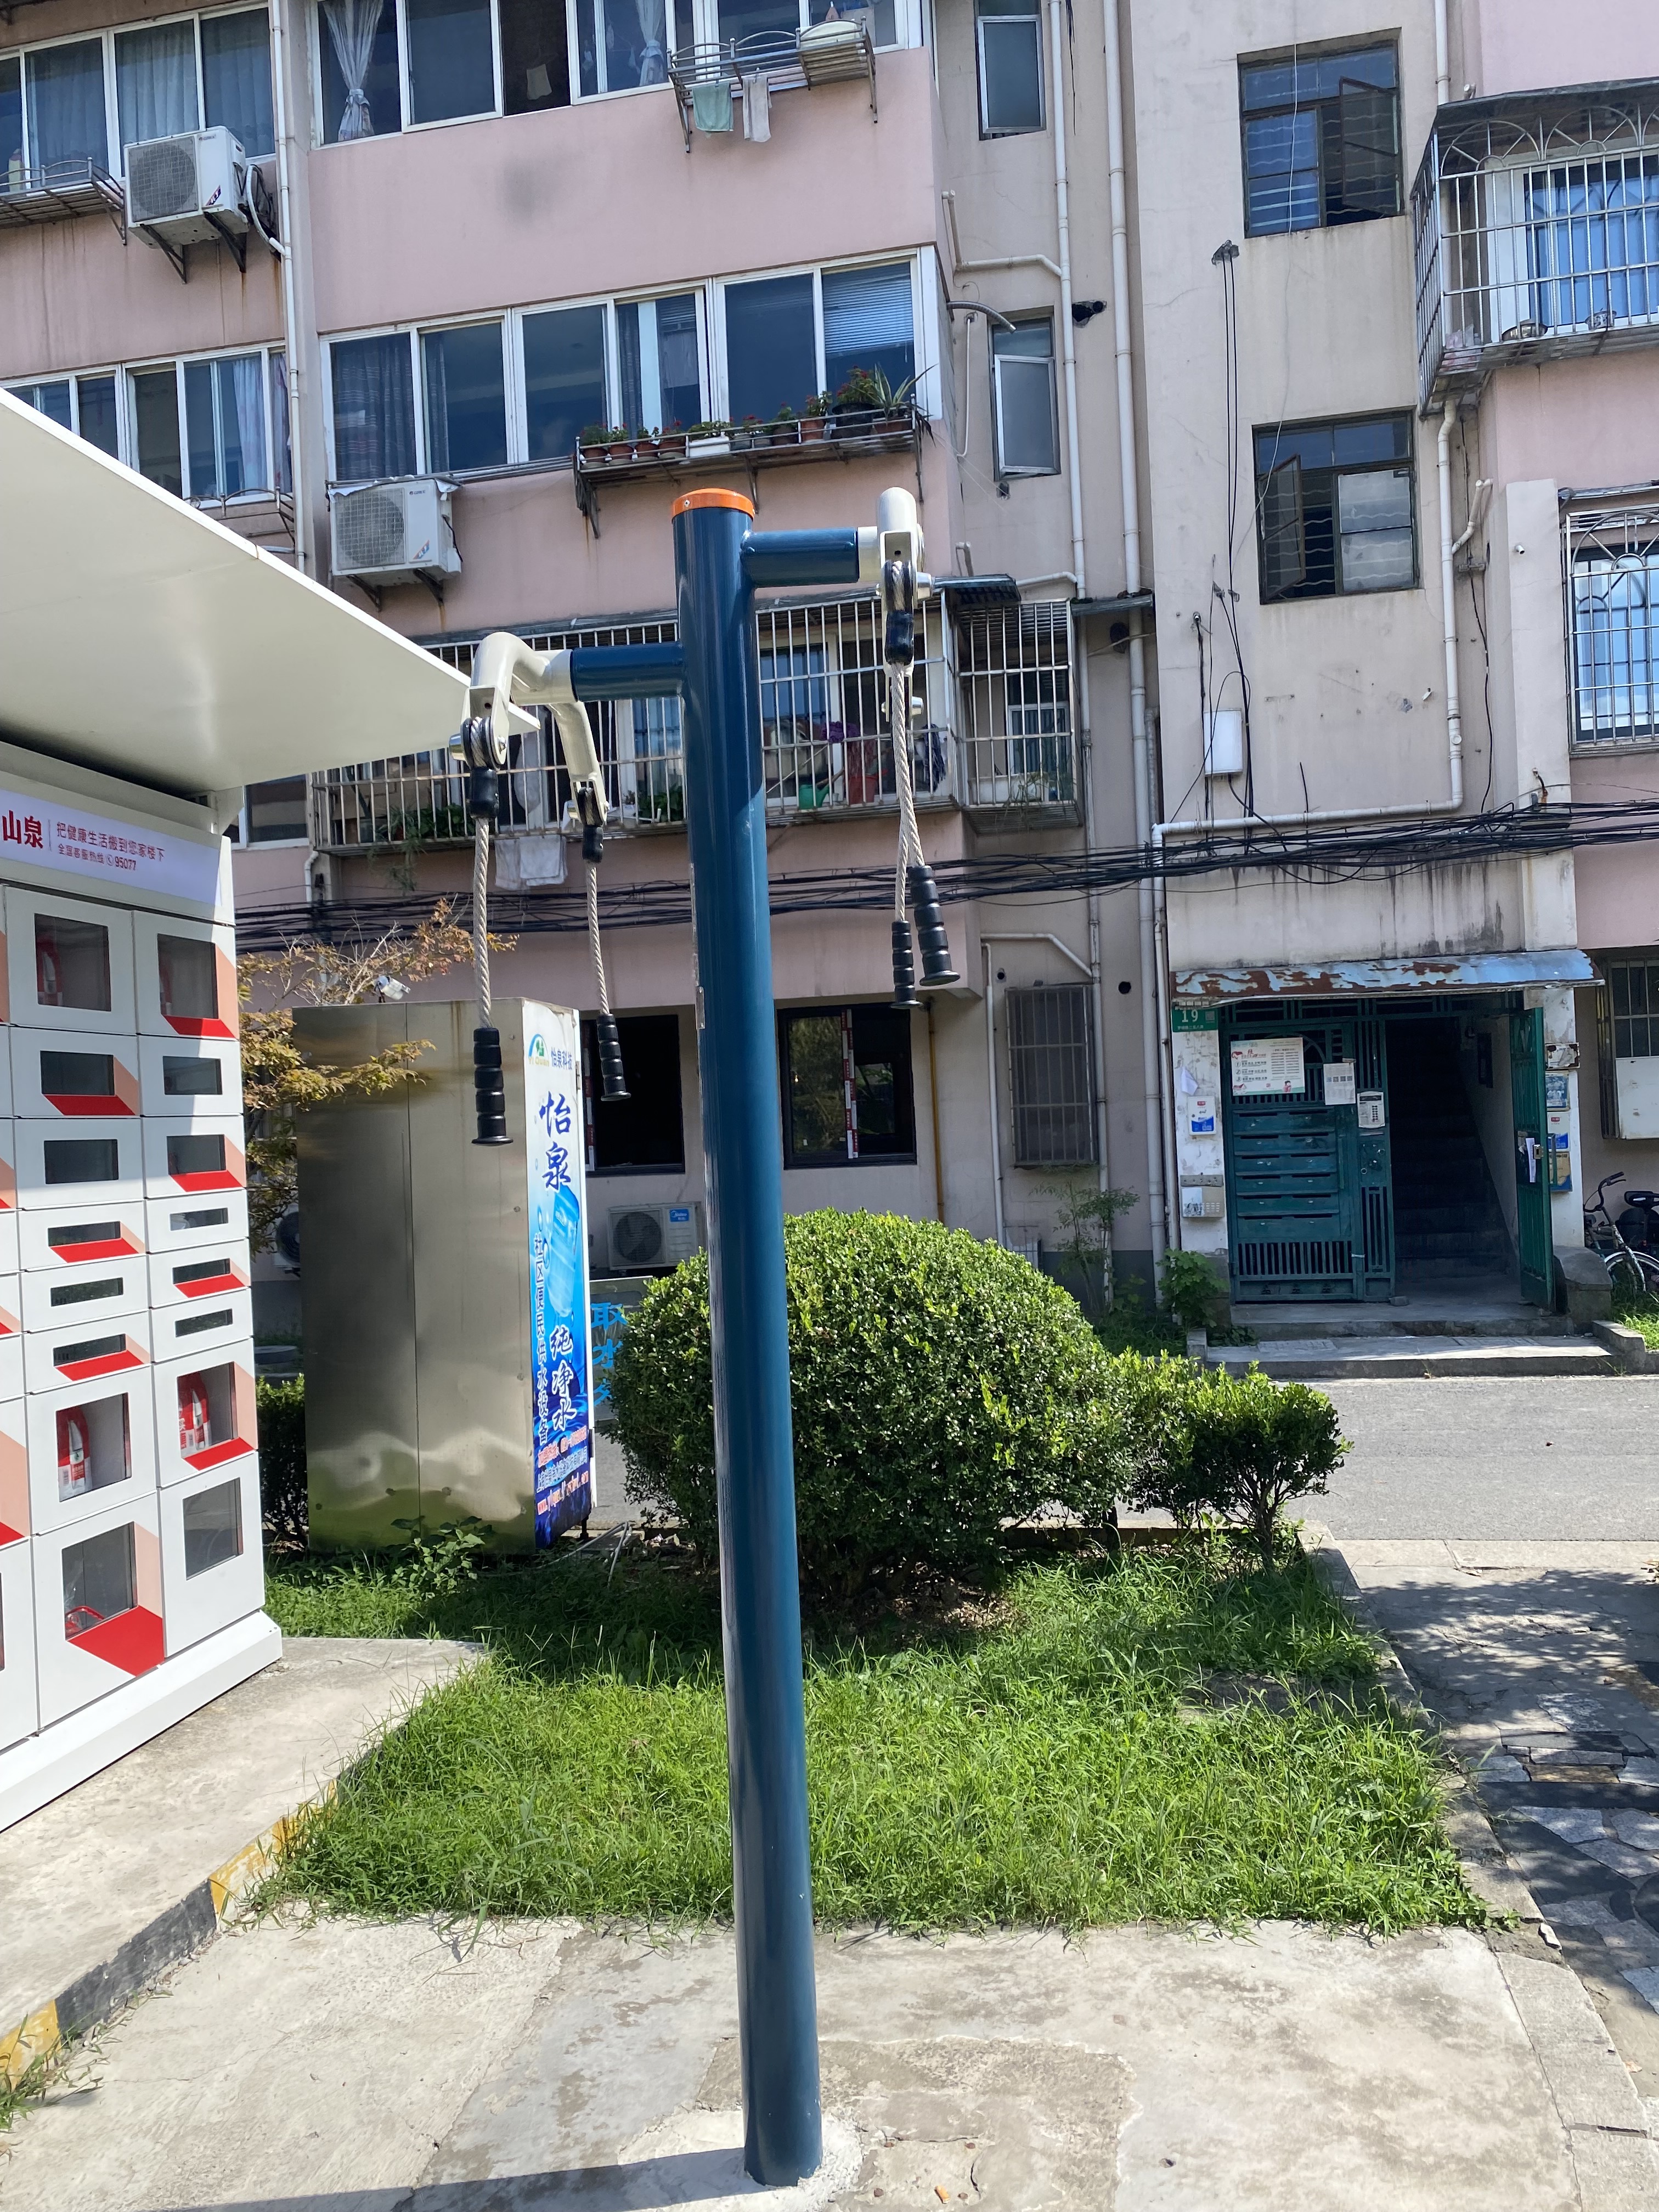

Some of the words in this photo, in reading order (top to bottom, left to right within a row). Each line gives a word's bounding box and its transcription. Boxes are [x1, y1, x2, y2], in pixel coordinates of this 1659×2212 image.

[2, 810, 43, 849] 山泉
[57, 821, 165, 861] 把健康生活搬到您家楼下
[115, 856, 137, 871] 95077
[1182, 1009, 1199, 1023] 19
[535, 1057, 550, 1067] Quan
[551, 1047, 572, 1070] 怡泉科技
[539, 1091, 571, 1191] 怡泉
[534, 1233, 548, 1445] 社区便民供水设备
[550, 1325, 576, 1430] 纯净水
